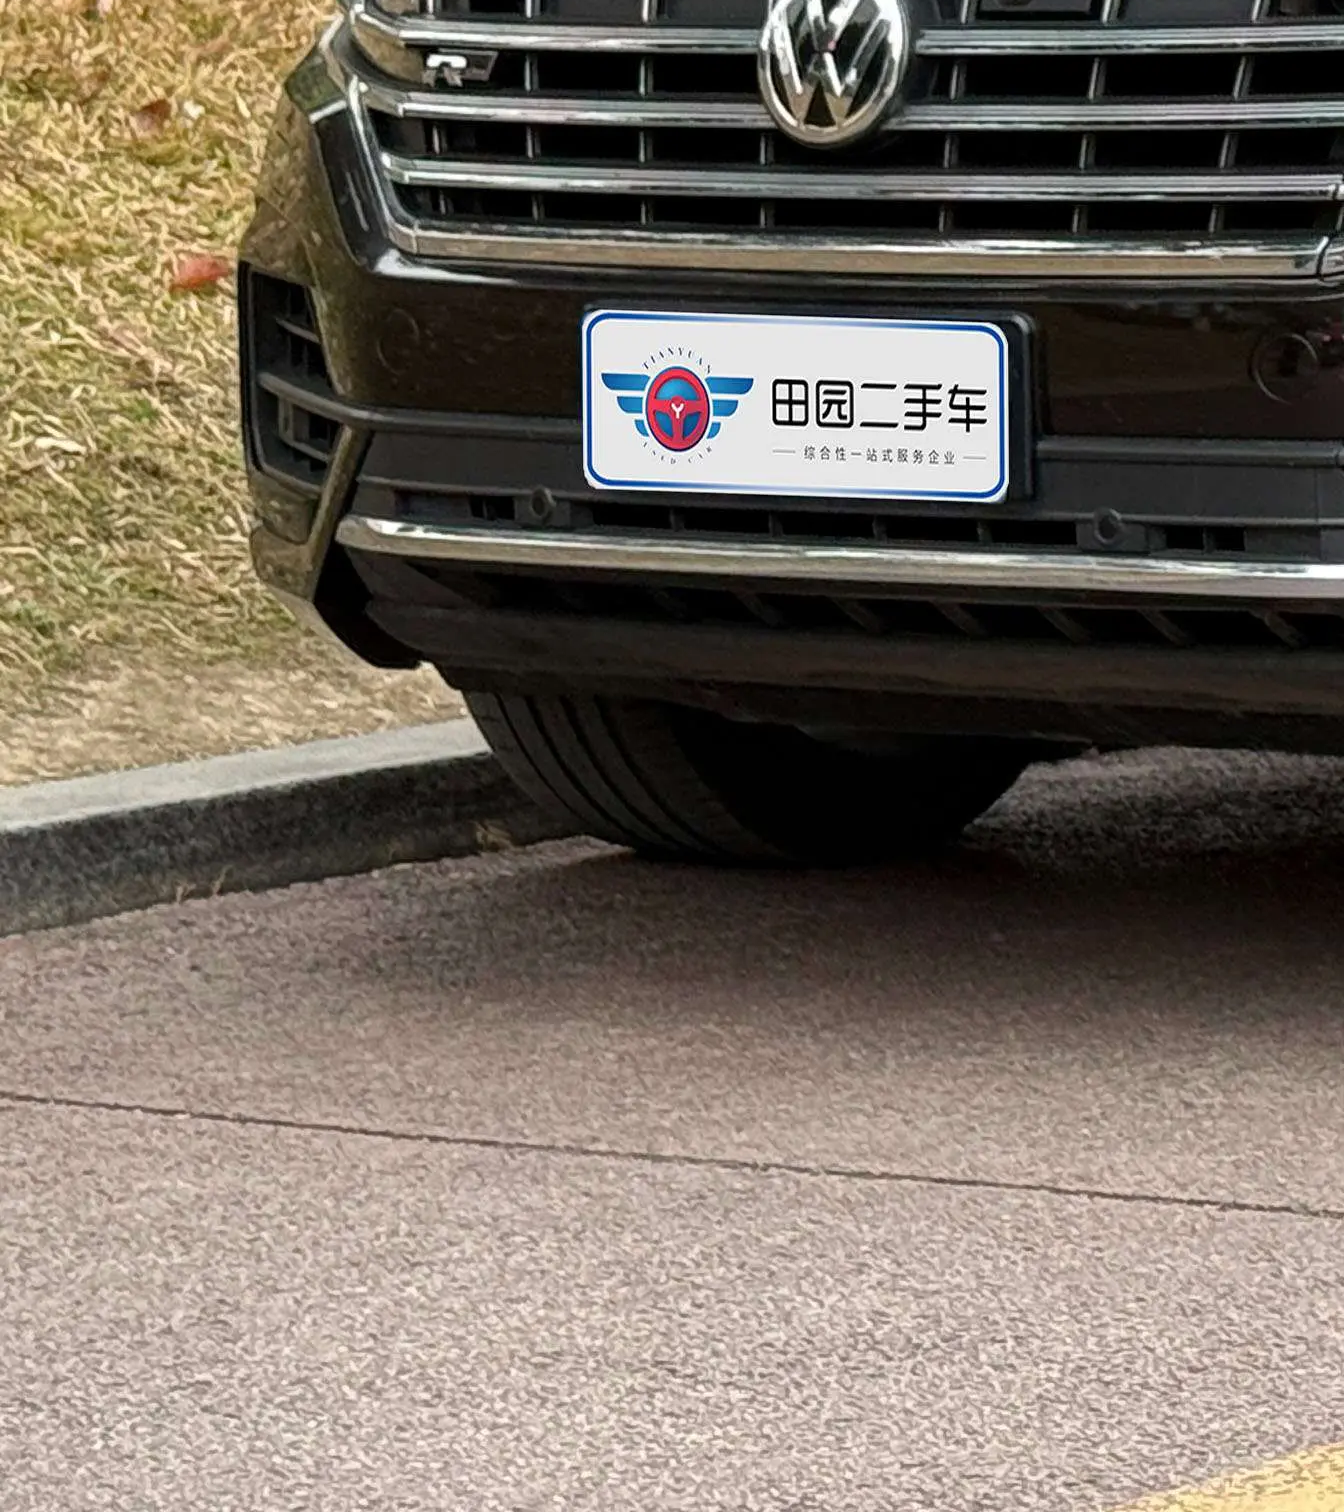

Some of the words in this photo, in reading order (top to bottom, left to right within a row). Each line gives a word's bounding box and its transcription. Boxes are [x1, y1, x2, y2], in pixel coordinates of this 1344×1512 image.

[772, 378, 988, 433] 田园二手车
[804, 445, 956, 465] 综合性一站式服务企业
